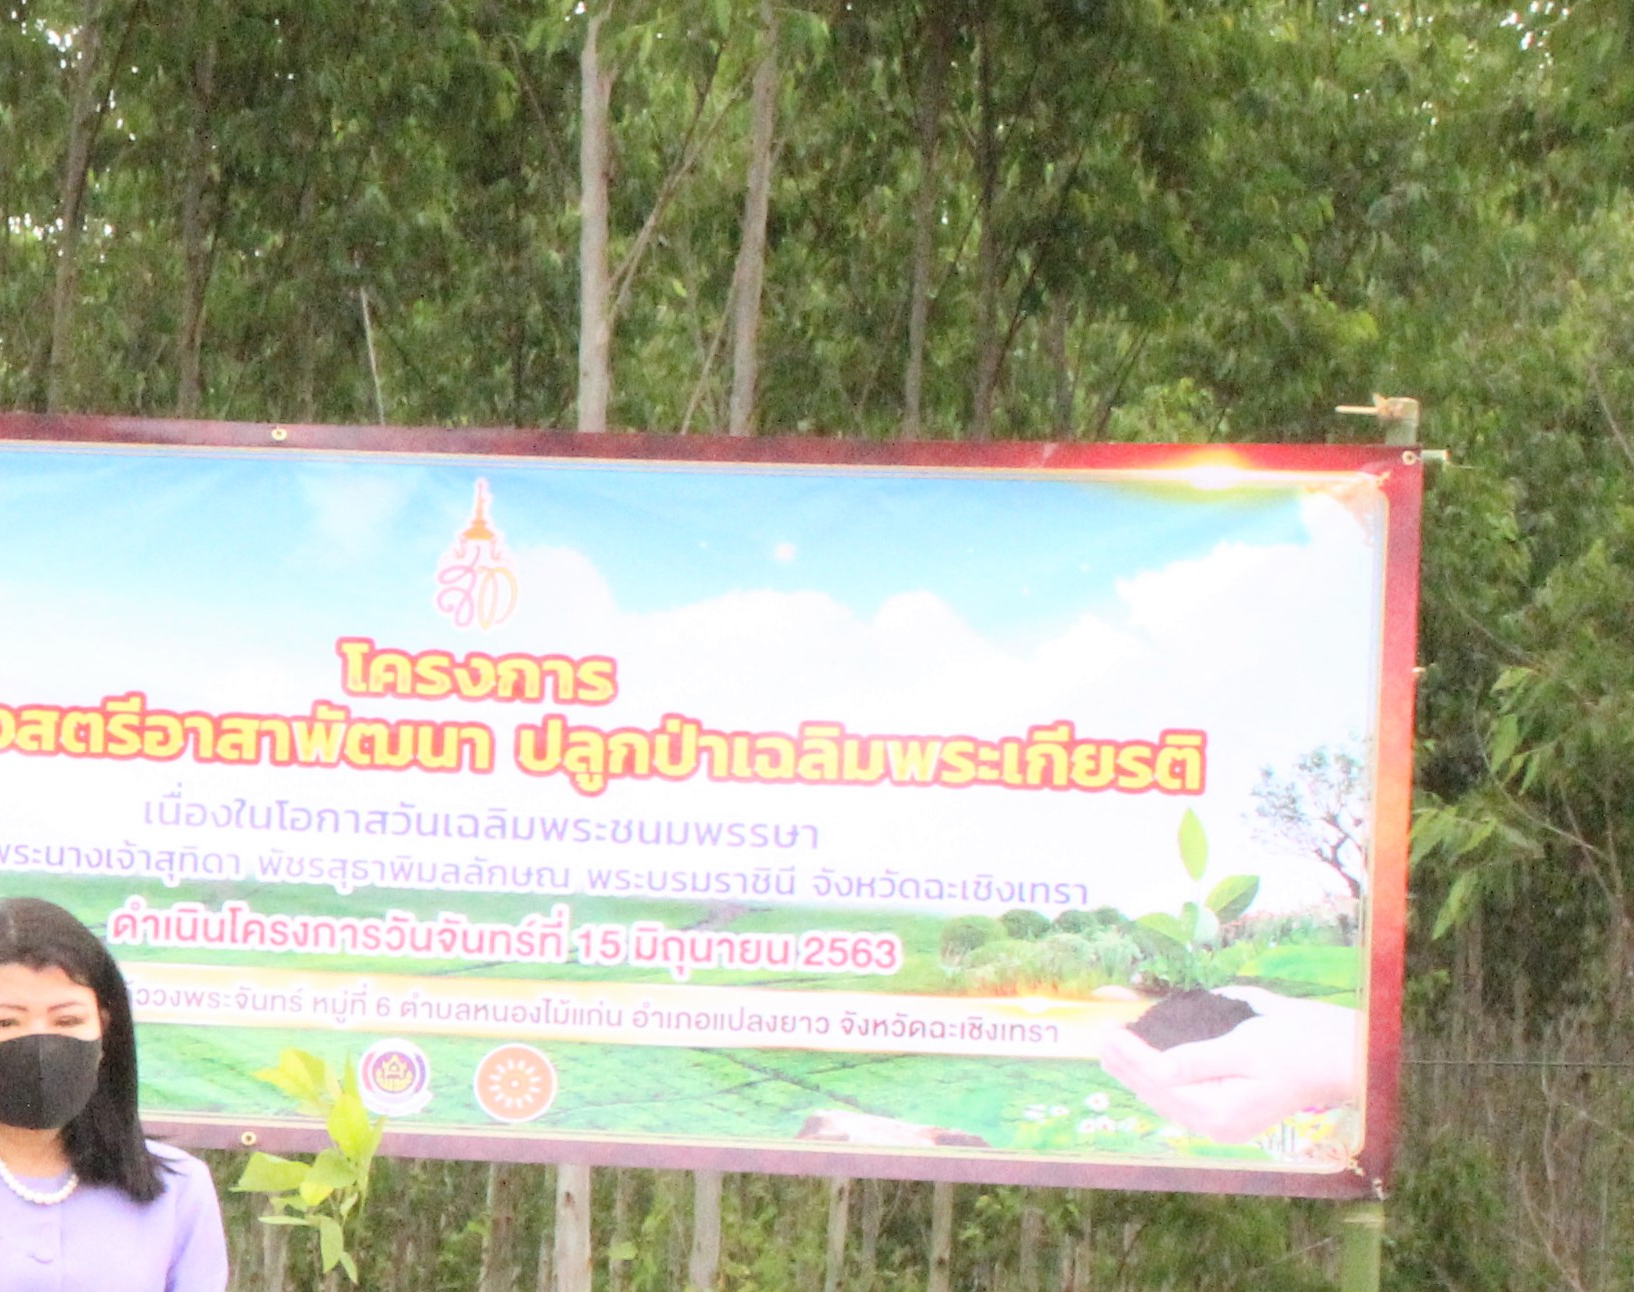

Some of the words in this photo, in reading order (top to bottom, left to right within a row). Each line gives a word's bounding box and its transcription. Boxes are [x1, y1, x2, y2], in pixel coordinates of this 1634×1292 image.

[336, 637, 618, 705] โครงการ
[515, 713, 1207, 795] ปลูกป่าเฉลิมพระเกียรติ
[143, 781, 820, 850] เนื่องในโอกาสวันเฉลิมพระชนมพรรษา
[587, 865, 797, 897] พระบรมราชินี
[812, 868, 1089, 906] จังหวัดฉะเชิงเทรา
[112, 902, 563, 958] ดำเนินโครงการวันจันทร์ที่
[577, 929, 622, 960] 15
[634, 927, 790, 976] มิถุนายน
[803, 936, 898, 969] 2563
[125, 979, 303, 1014] ววงพระจันทร์
[311, 982, 368, 1023] หมู่ที่
[375, 996, 392, 1017] 6
[840, 1010, 1060, 1044] จังหวัดฉะเชิงเทรา
